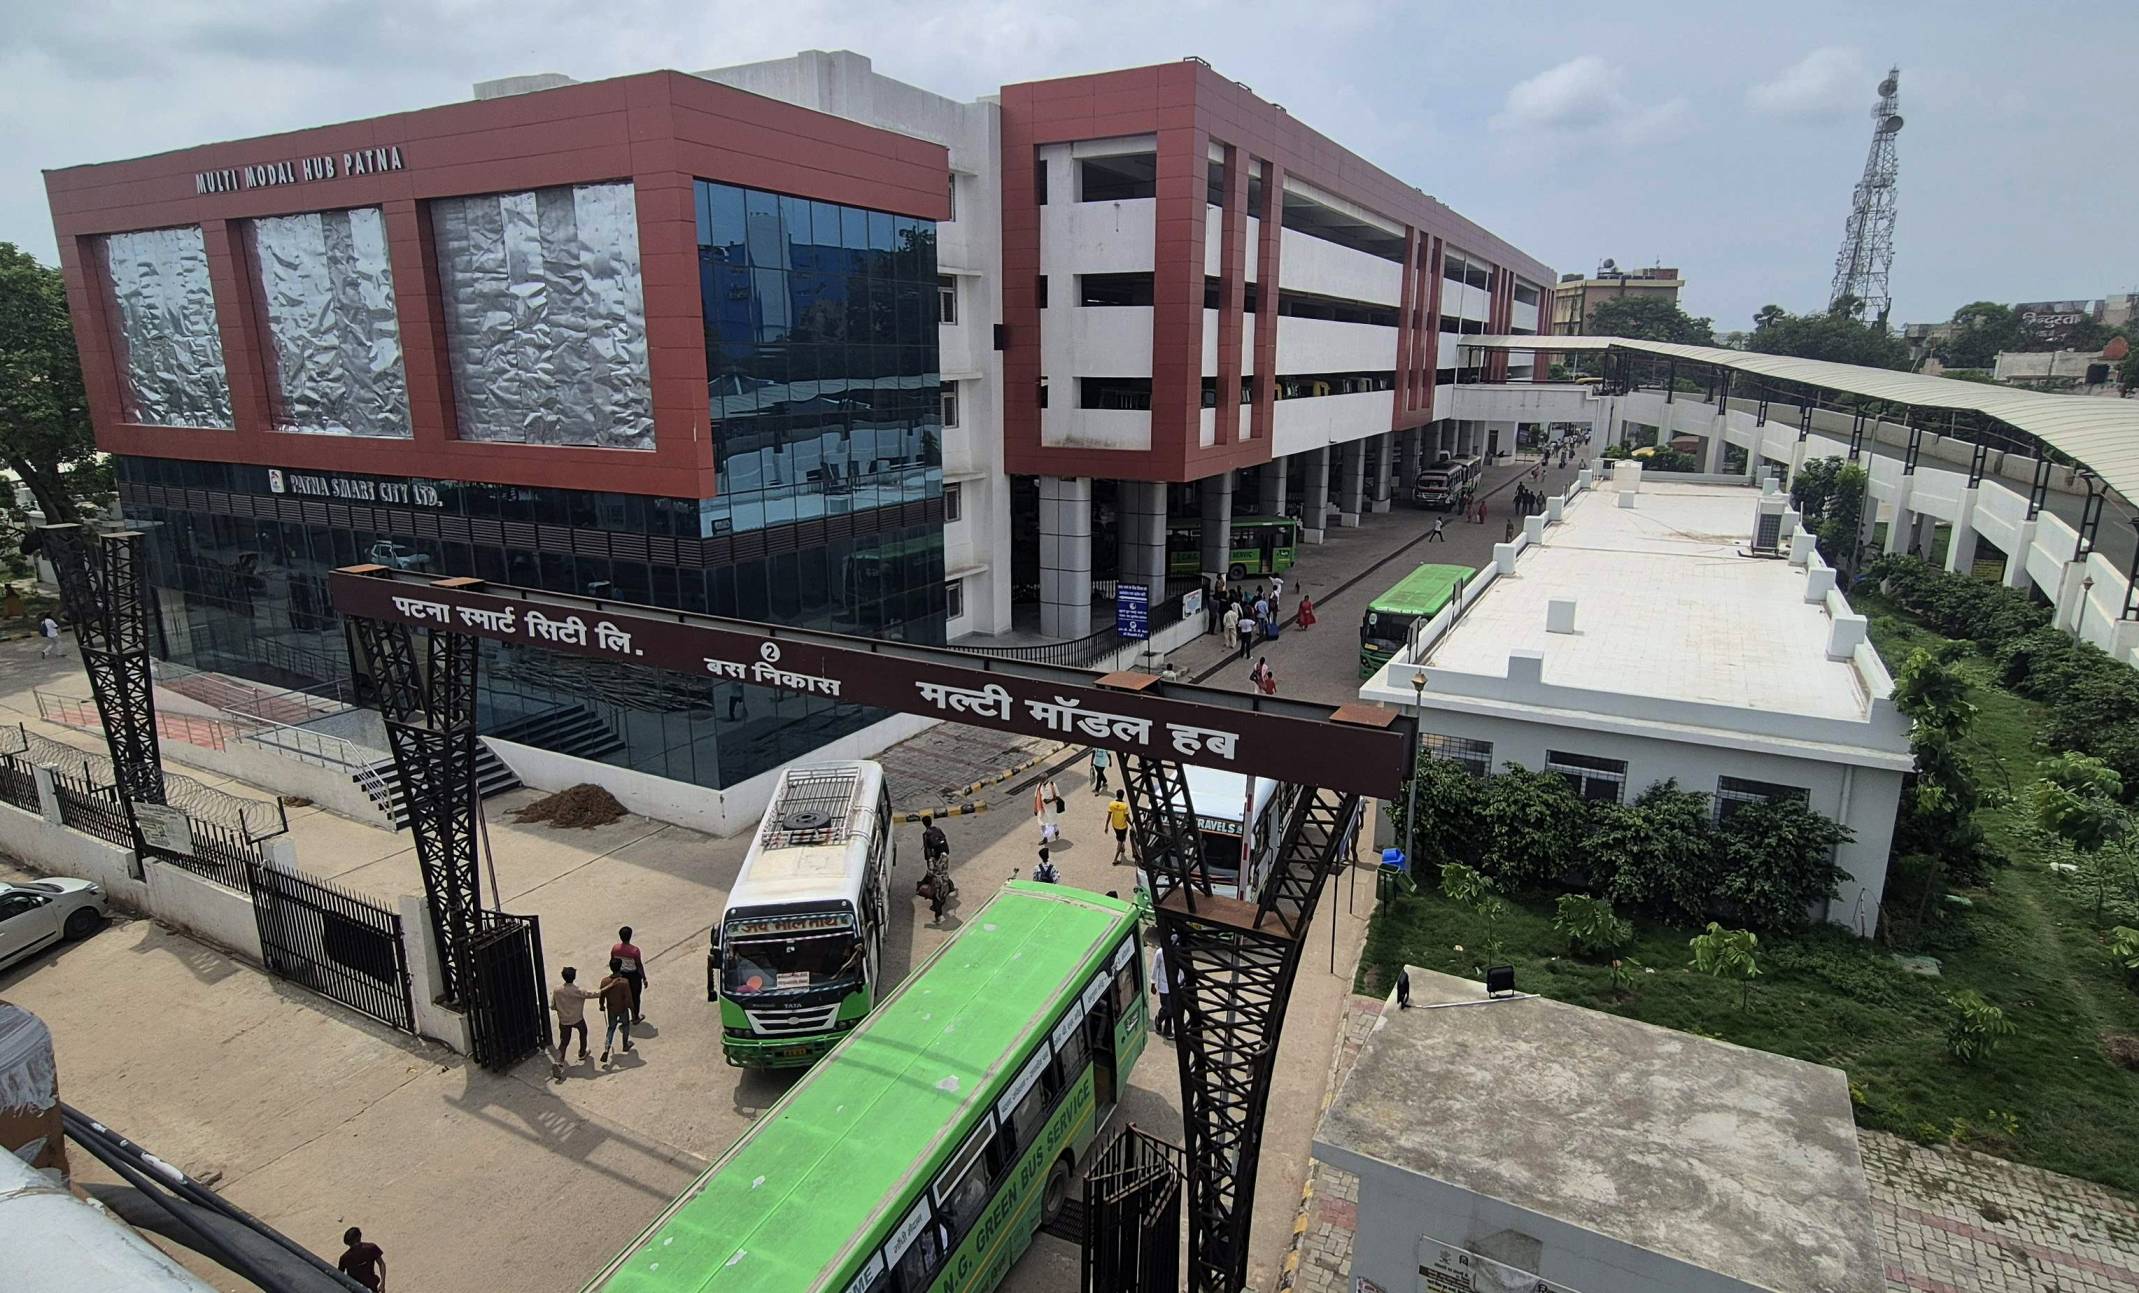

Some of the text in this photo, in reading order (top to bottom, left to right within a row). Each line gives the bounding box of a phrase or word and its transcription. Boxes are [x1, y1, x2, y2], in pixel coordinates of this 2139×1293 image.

[195, 146, 402, 194] MULTI MODAL HUB PATNA
[289, 474, 444, 507] PATNA SMART CITY LTD.
[392, 595, 644, 656] पटना स्मार्ट सिटी लि.
[703, 657, 841, 696] बस निकास
[915, 681, 1240, 761] मल्टी मॉडल हब
[1196, 817, 1236, 833] RAVELS
[976, 1181, 1017, 1251] GREEN
[1021, 1145, 1044, 1190] BUS
[1047, 1078, 1090, 1152] SERVICE
[852, 1266, 873, 1293] ME
